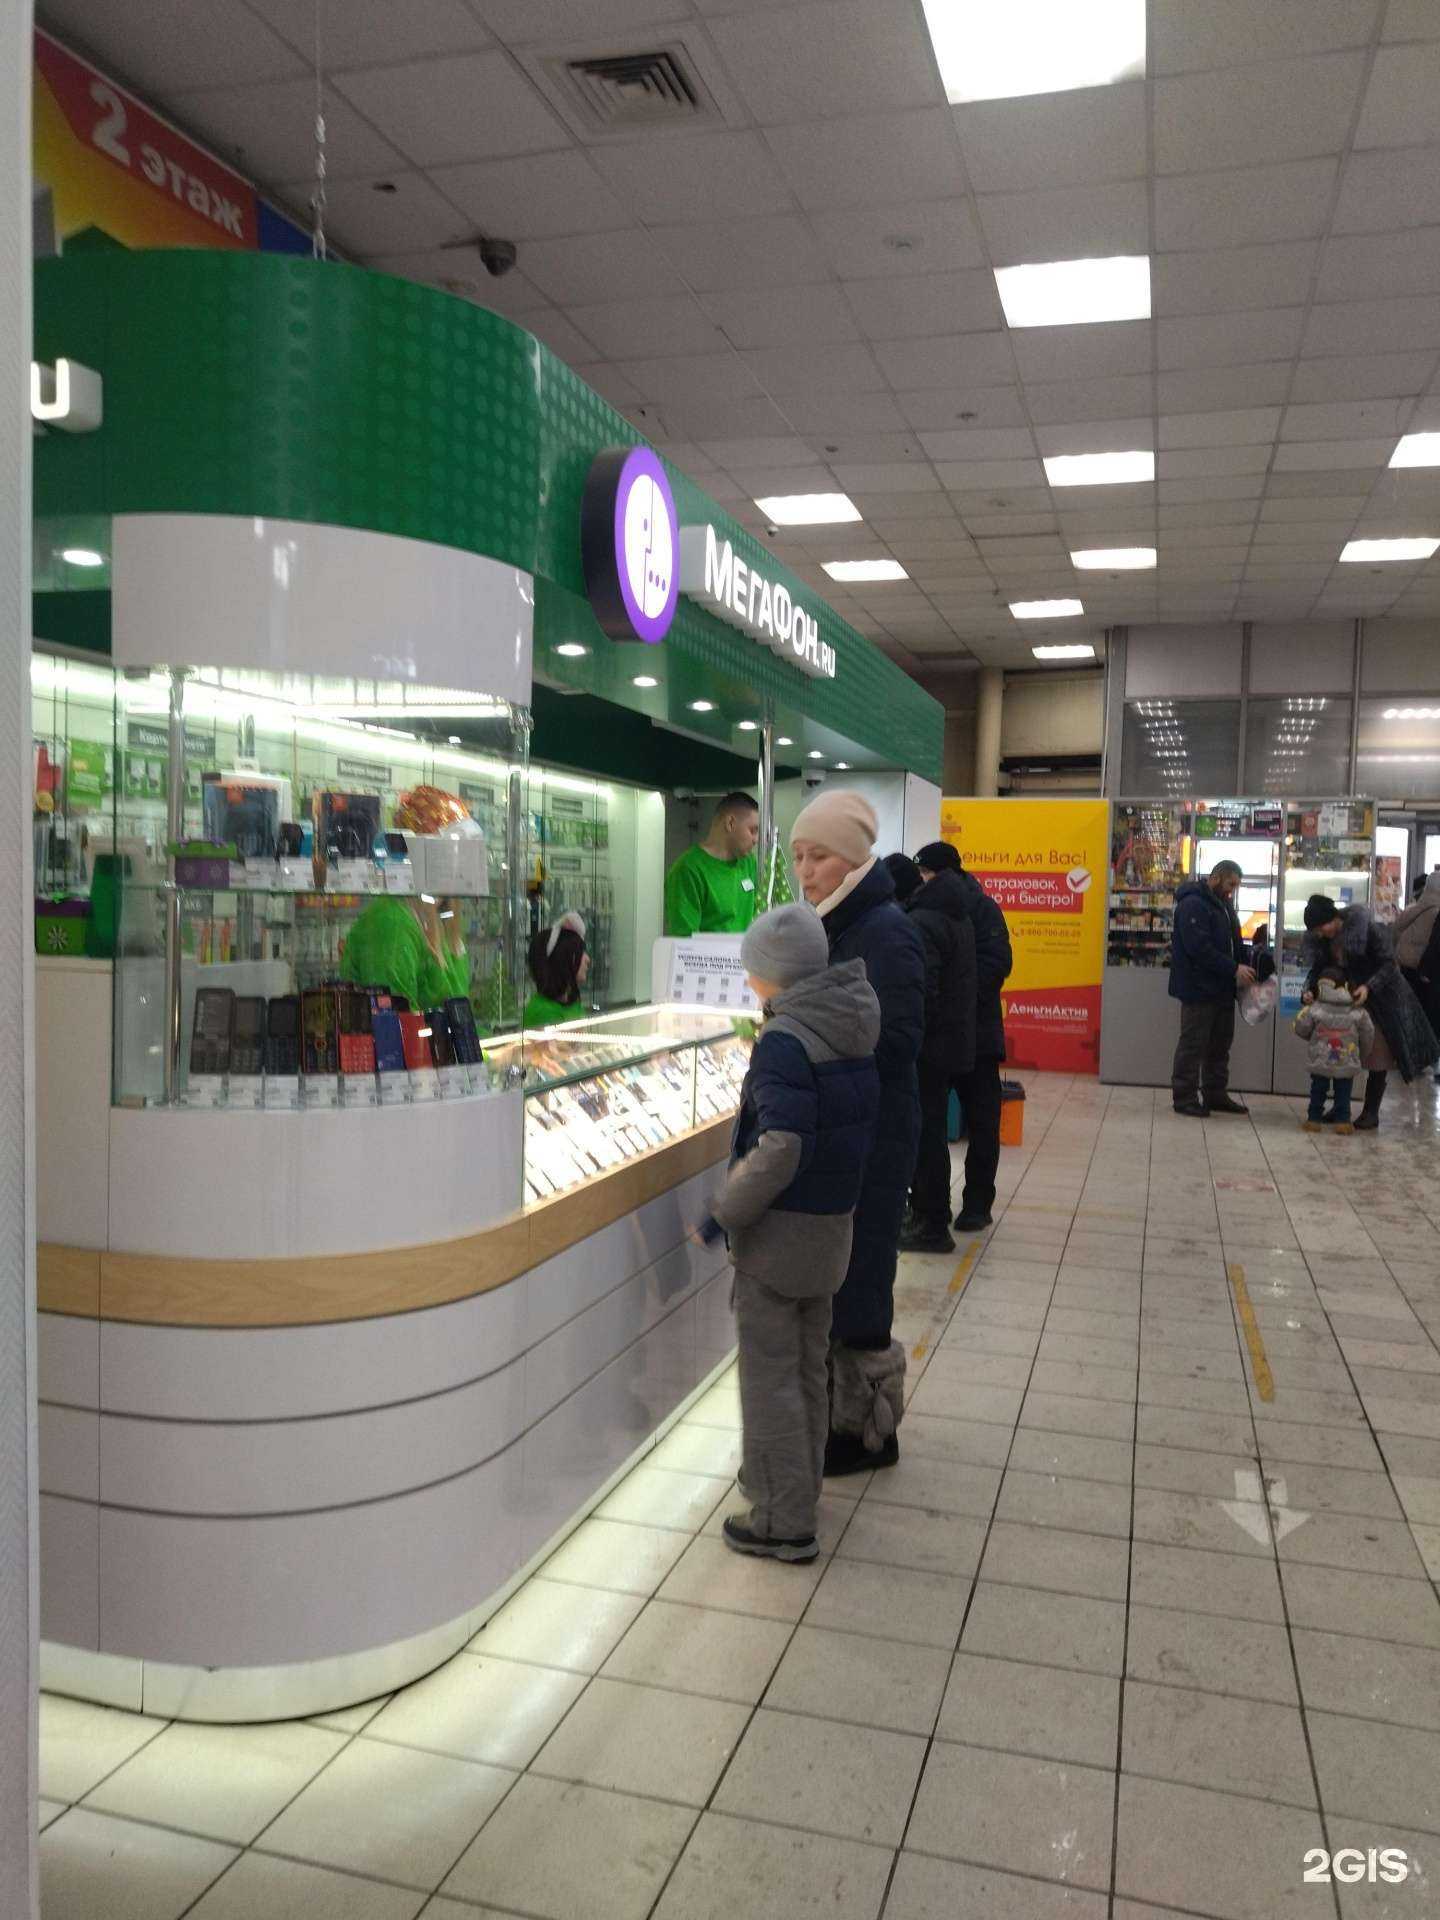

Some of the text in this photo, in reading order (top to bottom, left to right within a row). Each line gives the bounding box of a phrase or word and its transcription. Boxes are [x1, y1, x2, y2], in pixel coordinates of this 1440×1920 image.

[90, 81, 244, 239] 2 этаж
[960, 850, 1087, 867] еньги для Вас!
[984, 876, 1059, 891] страховок,
[1006, 894, 1016, 904] и
[1019, 890, 1075, 908] быстро!
